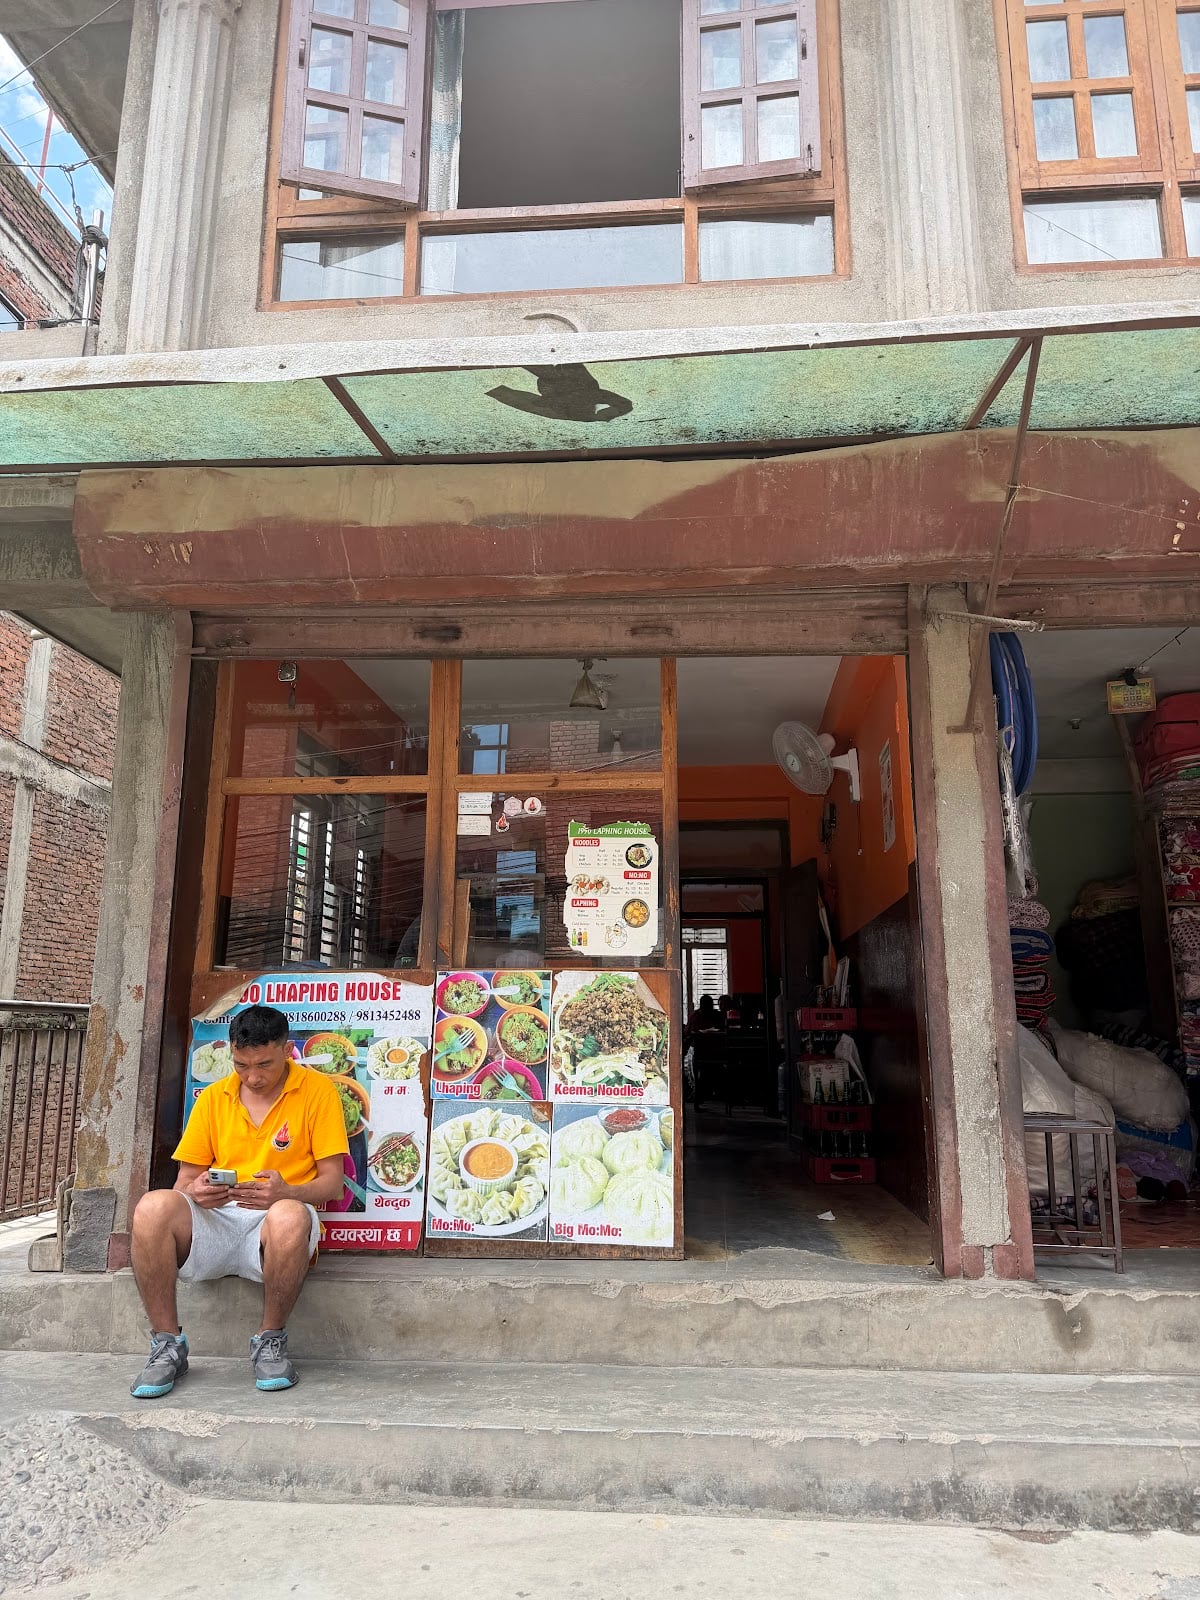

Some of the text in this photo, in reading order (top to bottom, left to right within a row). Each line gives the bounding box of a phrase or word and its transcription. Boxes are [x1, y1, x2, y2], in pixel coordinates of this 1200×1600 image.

[593, 827, 623, 835] LAPHING
[624, 827, 648, 835] HOUSE
[574, 839, 599, 847] NOODLES
[573, 899, 597, 907] LAPHING
[266, 982, 338, 1003] LHAPING
[345, 981, 401, 1001] HOUSE
[356, 1009, 421, 1021] 9813452488
[435, 1081, 481, 1097] Lhaping
[554, 1083, 644, 1097] Keema Noodles
[431, 1218, 475, 1232] Mo:Mo:
[554, 1223, 622, 1238] Big Mo:Mo:
[330, 1228, 383, 1243] व्यवस्था
